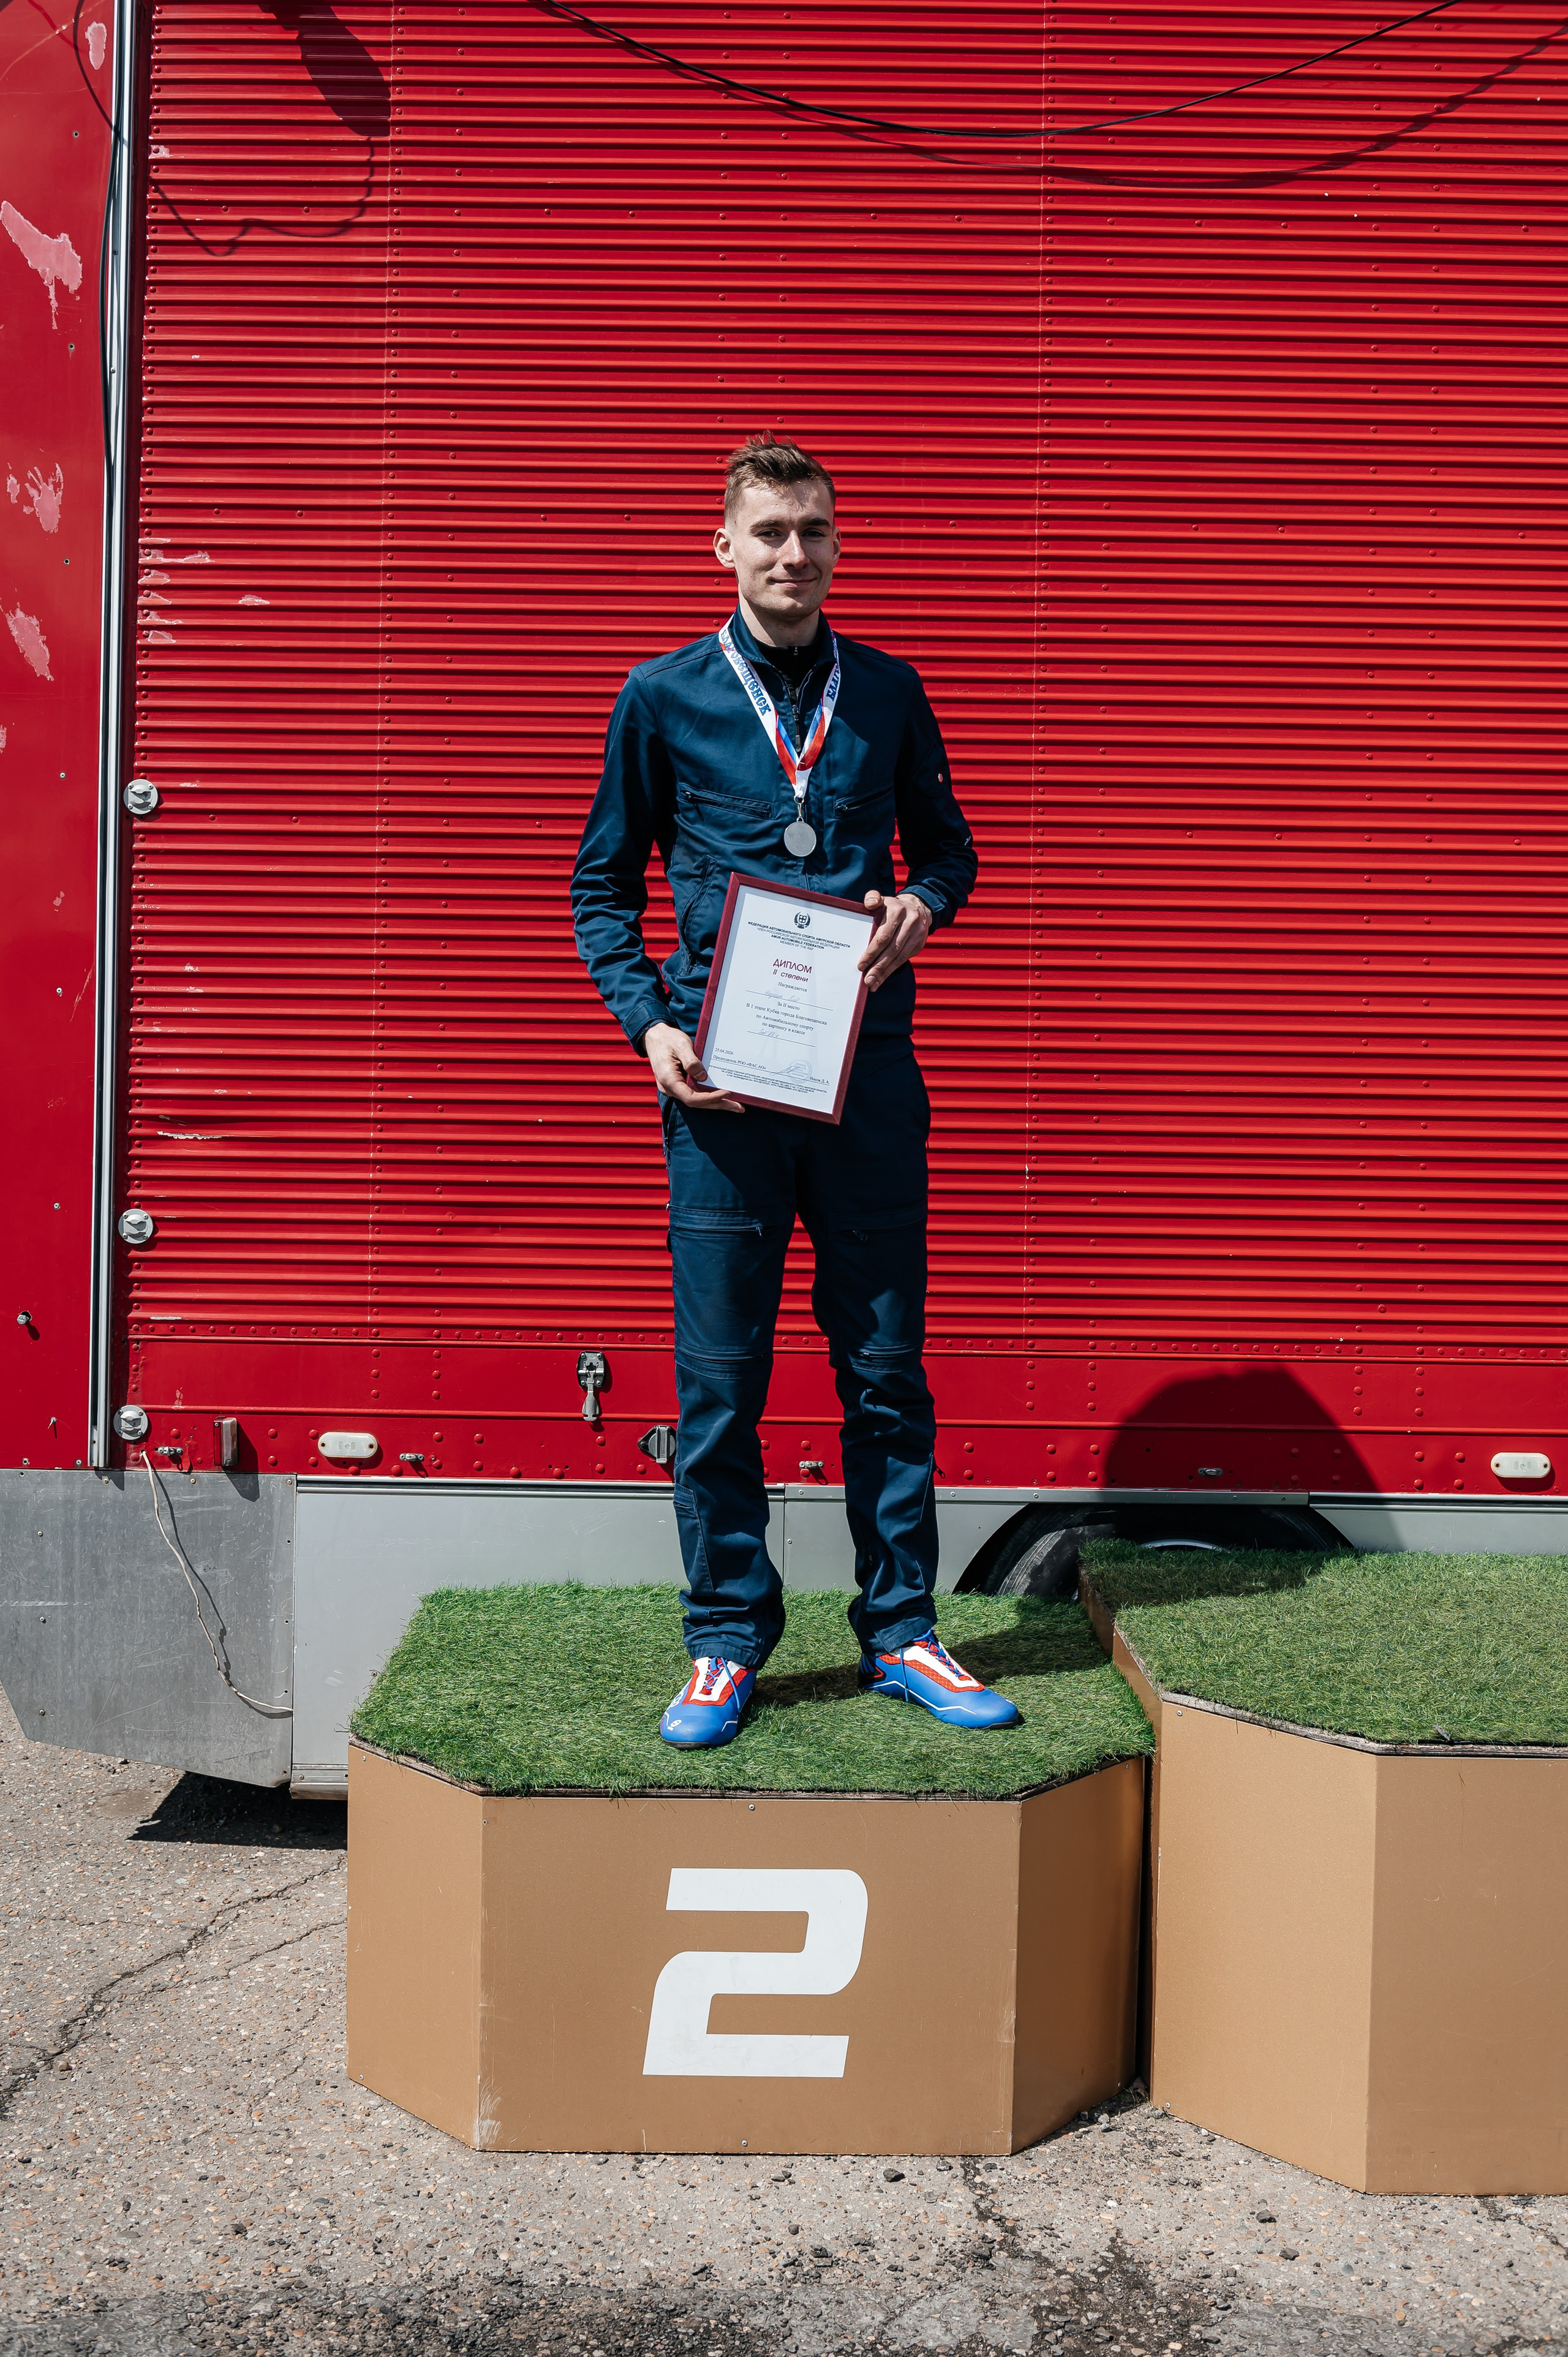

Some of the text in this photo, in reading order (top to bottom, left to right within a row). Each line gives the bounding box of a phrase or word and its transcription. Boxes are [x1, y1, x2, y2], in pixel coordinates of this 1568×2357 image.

[769, 926, 801, 937] АВТОМОБИЛЬНОГО
[772, 958, 812, 974] ДИПЛОМ
[780, 971, 809, 982] степени
[778, 981, 807, 992] Награждается
[762, 1015, 799, 1028] Автомобильному
[795, 1014, 827, 1025] Благовещенска
[713, 1054, 737, 1063] Председатель
[643, 1868, 869, 2078] 2
